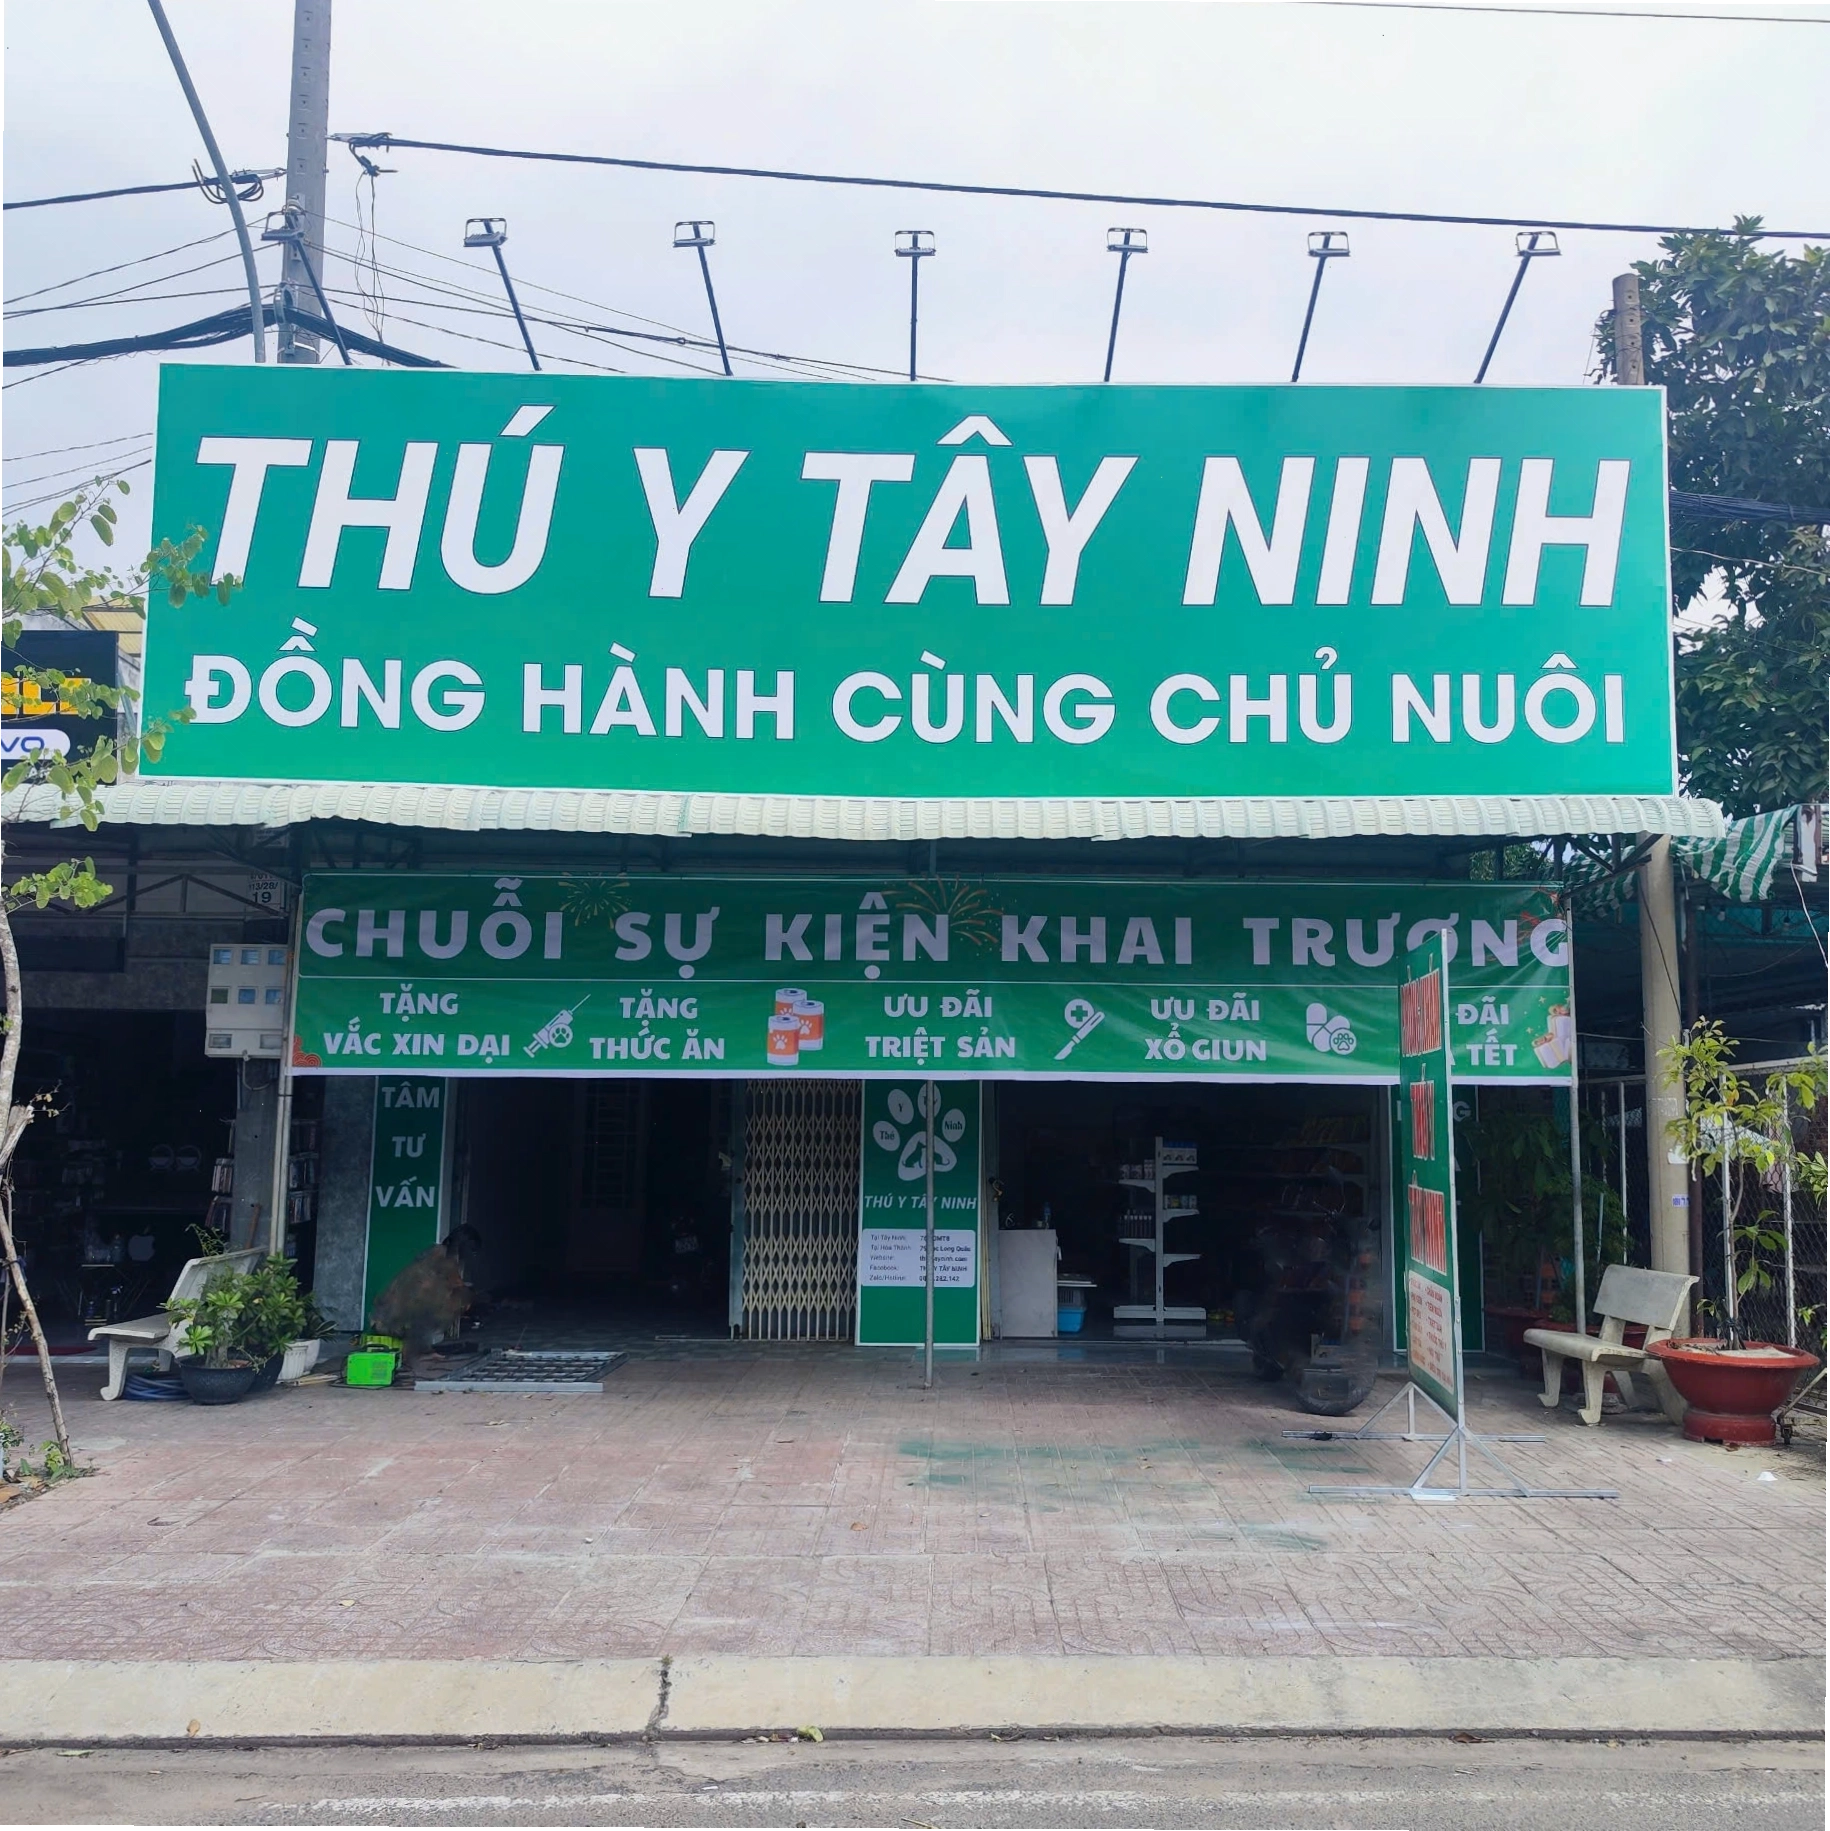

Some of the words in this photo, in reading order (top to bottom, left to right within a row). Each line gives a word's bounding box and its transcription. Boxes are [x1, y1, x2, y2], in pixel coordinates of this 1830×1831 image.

[195, 405, 566, 594] THÚ
[632, 447, 750, 598] Y
[801, 415, 1139, 606] TÂY
[1182, 455, 1631, 606] NINH
[184, 617, 485, 732] ĐỒNG
[522, 641, 796, 740] HÀNH
[831, 651, 1116, 744] CÙNG
[1150, 646, 1352, 744] CHỦ
[1392, 652, 1624, 744] NUÔI
[305, 877, 562, 960] CHUỖI
[615, 907, 720, 979] SỰ
[765, 892, 948, 980] KIỆN
[1001, 915, 1192, 965] KHAI
[380, 984, 459, 1022] TẶNG
[620, 989, 698, 1027] TẶNG
[884, 993, 928, 1018] ƯU
[940, 989, 992, 1018] ĐÃI
[1151, 996, 1195, 1021] ƯU
[1207, 992, 1260, 1021] ĐÃI
[1455, 995, 1509, 1025] ĐÃI
[324, 1017, 381, 1055] VẮC
[392, 1033, 444, 1056] XIN
[458, 1034, 510, 1064] DẠI
[590, 1028, 671, 1060] THỨC
[682, 1028, 725, 1060] ĂN
[865, 1027, 946, 1066] TRIỆT
[957, 1027, 1016, 1059] SẢN
[1145, 1022, 1186, 1060] XỔ
[1192, 1039, 1266, 1062] GIUN
[1466, 1029, 1517, 1066] TẾT
[382, 1081, 440, 1108] TÂM
[392, 1133, 427, 1158] TƯ
[375, 1175, 436, 1208] VẤN
[864, 1192, 893, 1208] THÚ
[898, 1196, 907, 1208] Y
[911, 1193, 938, 1208] TÂ
[941, 1196, 978, 1209] NINH
